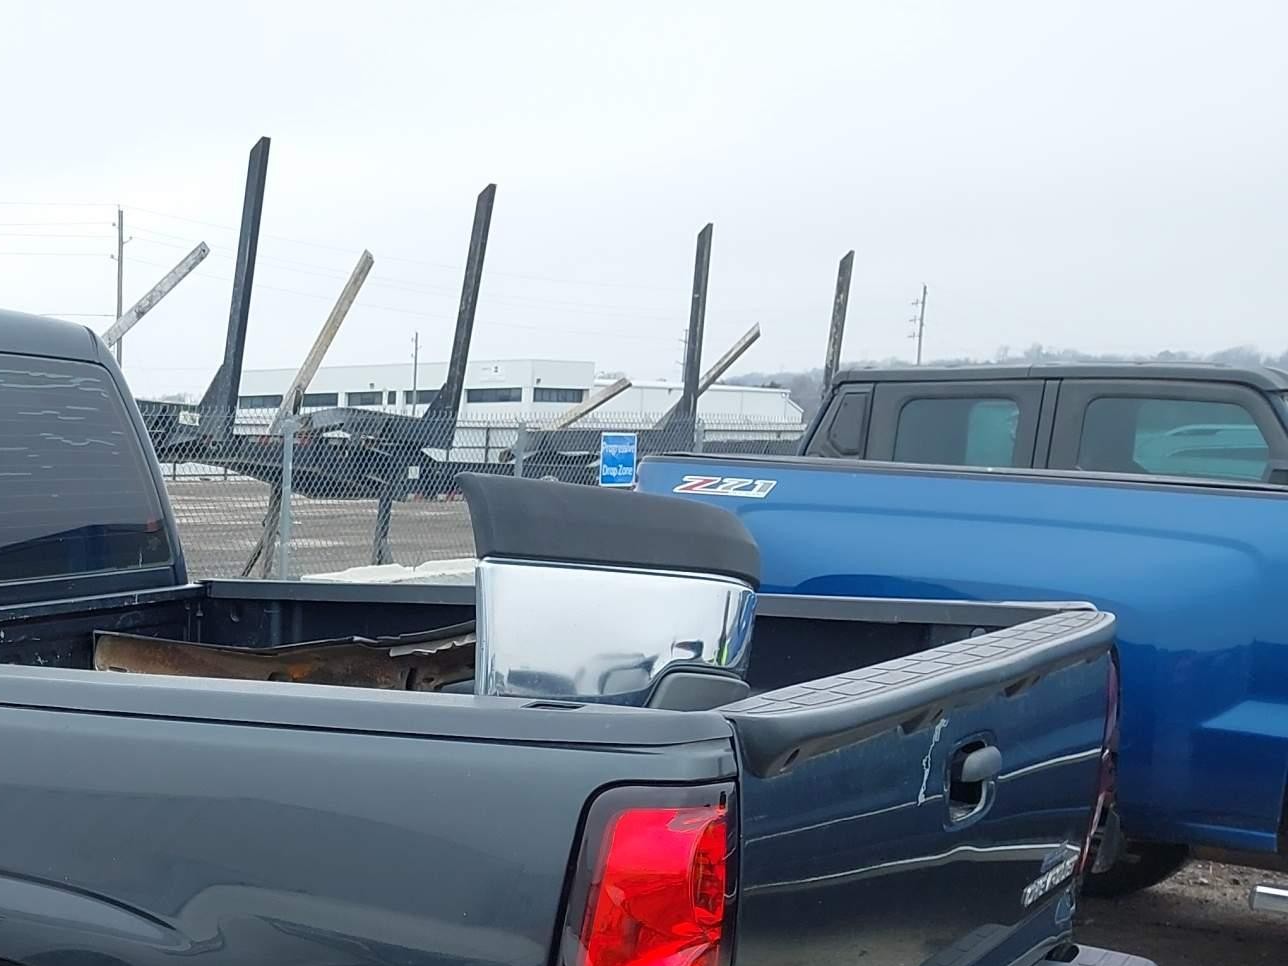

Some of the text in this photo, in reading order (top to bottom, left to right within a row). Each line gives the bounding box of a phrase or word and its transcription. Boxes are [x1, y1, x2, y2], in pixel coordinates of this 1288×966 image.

[602, 464, 633, 478] Drop Zone
[673, 475, 777, 498] Z71
